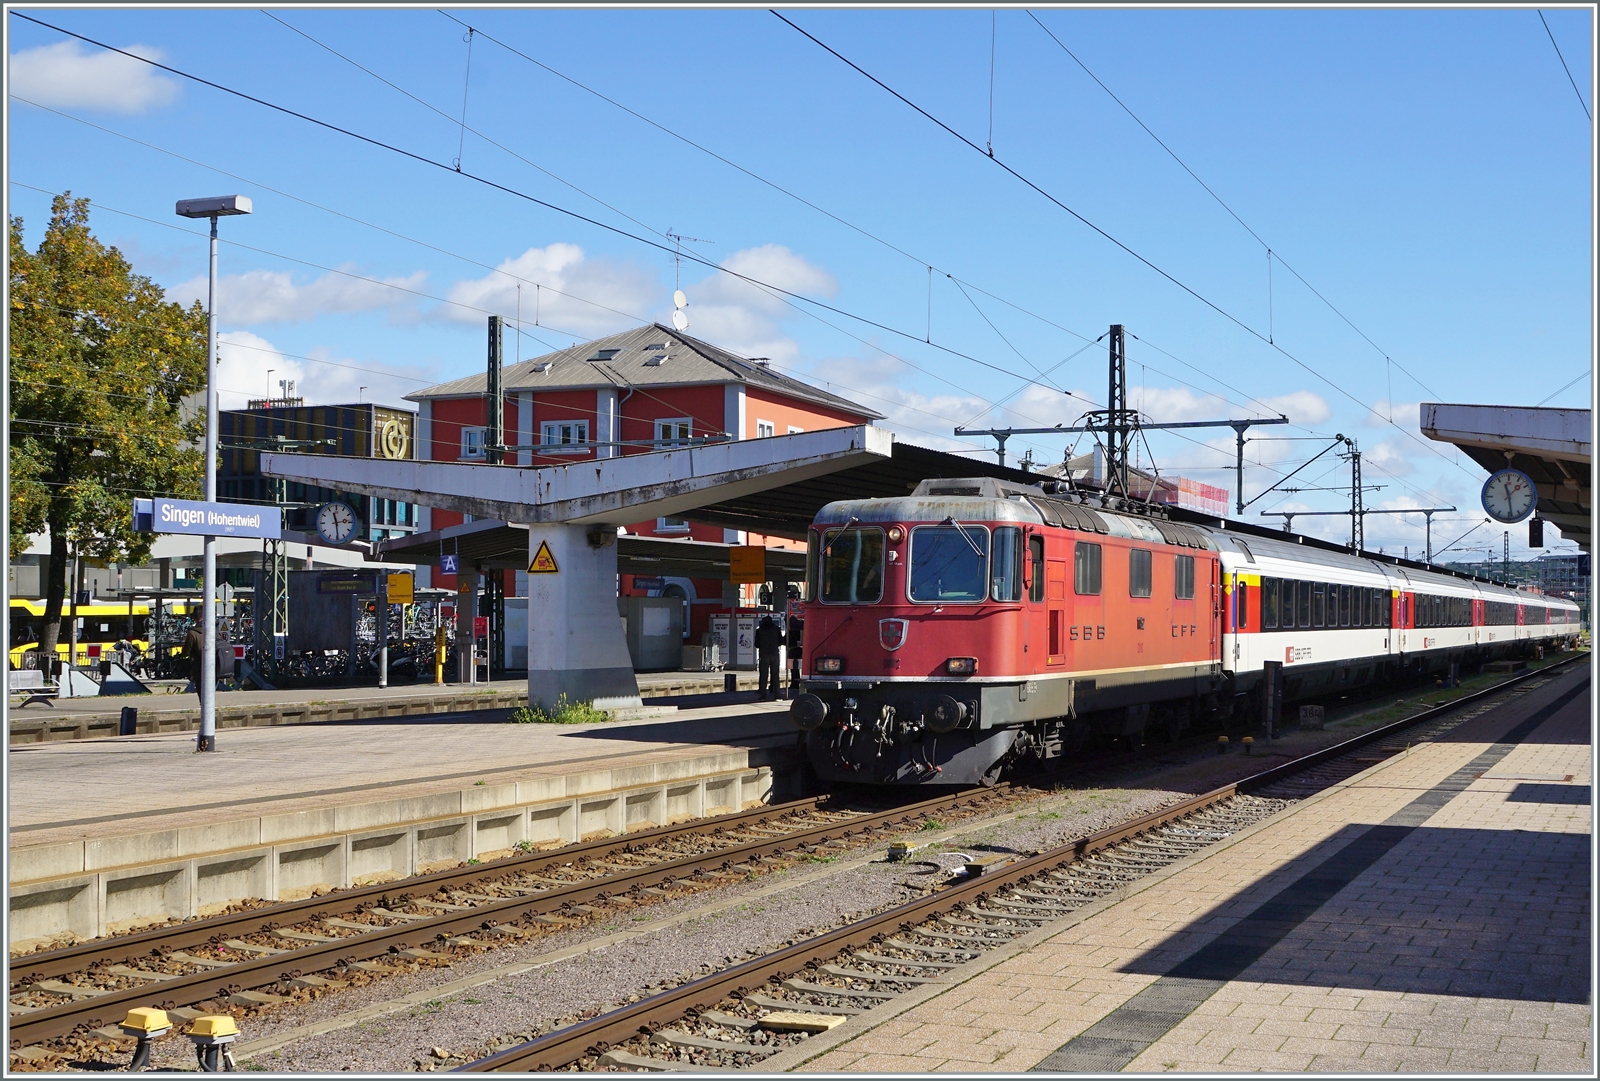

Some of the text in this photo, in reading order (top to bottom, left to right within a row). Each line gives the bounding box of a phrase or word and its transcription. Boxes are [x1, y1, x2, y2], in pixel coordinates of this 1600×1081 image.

[161, 503, 261, 529] Singen (Hohentwiel)
[445, 555, 456, 571] A
[81, 591, 88, 604] 7
[761, 592, 768, 602] 6
[1069, 624, 1197, 641] SBB CFF
